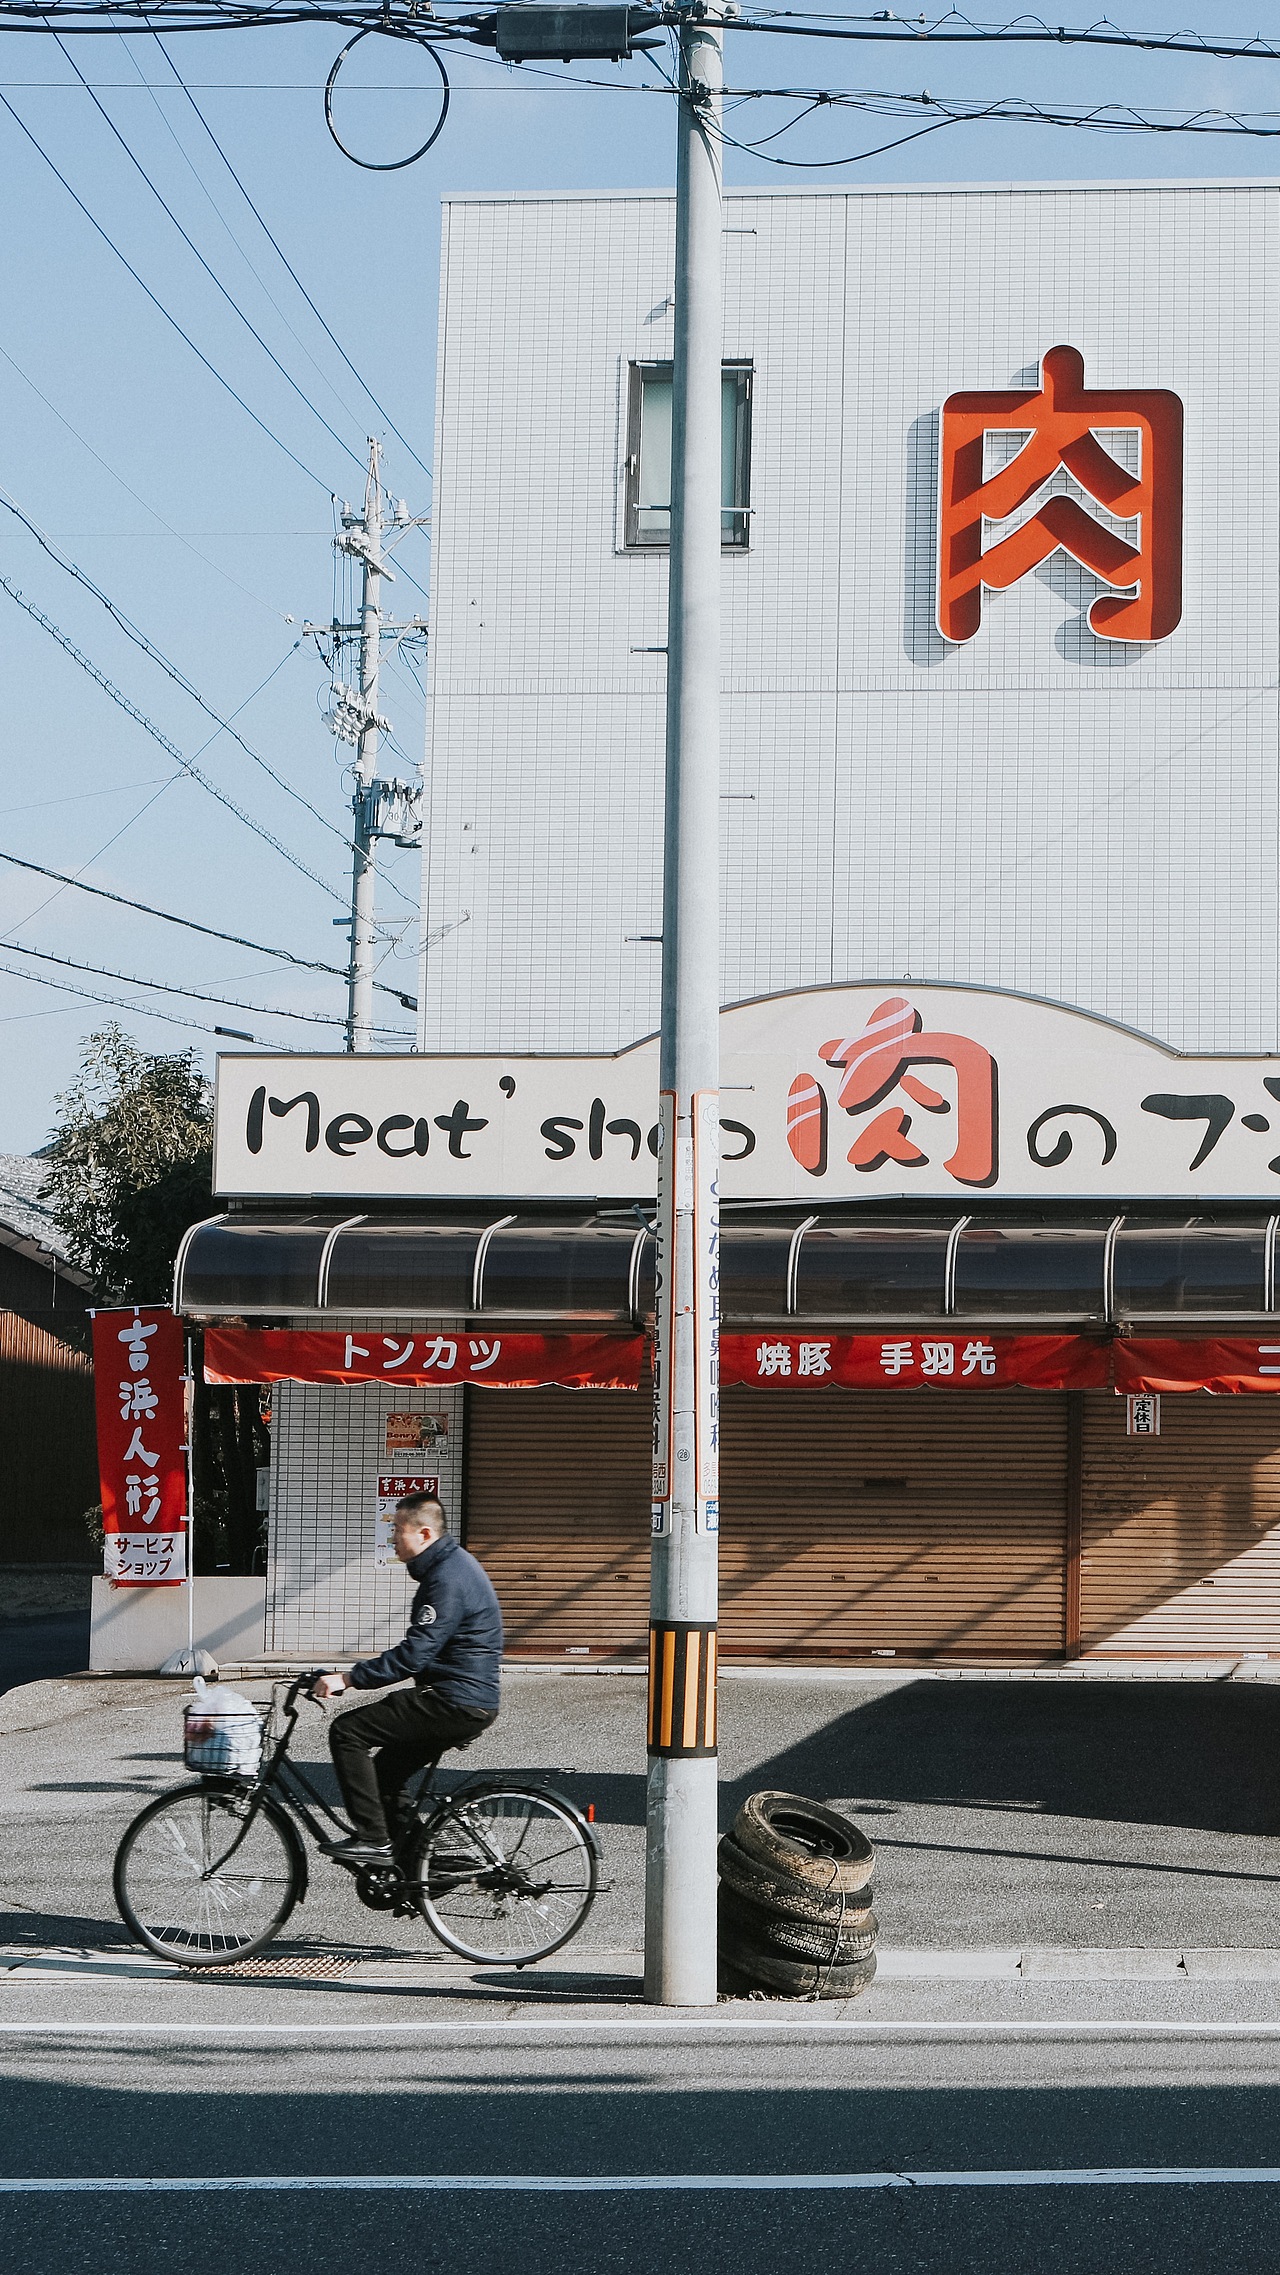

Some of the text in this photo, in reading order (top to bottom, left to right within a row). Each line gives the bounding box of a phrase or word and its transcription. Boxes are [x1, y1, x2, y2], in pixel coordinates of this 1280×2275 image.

[936, 344, 1184, 645] 肉
[540, 1097, 756, 1161] shp
[345, 1334, 501, 1371] トンカツ
[756, 1341, 997, 1376] 焼豚 手羽先
[117, 1319, 162, 1525] 吉浜人形
[1134, 1400, 1151, 1432] 定休日
[679, 1451, 688, 1459] 28
[381, 1477, 435, 1493] 吉浜人形
[114, 1537, 174, 1555] サービス
[117, 1557, 172, 1576] ショップ
